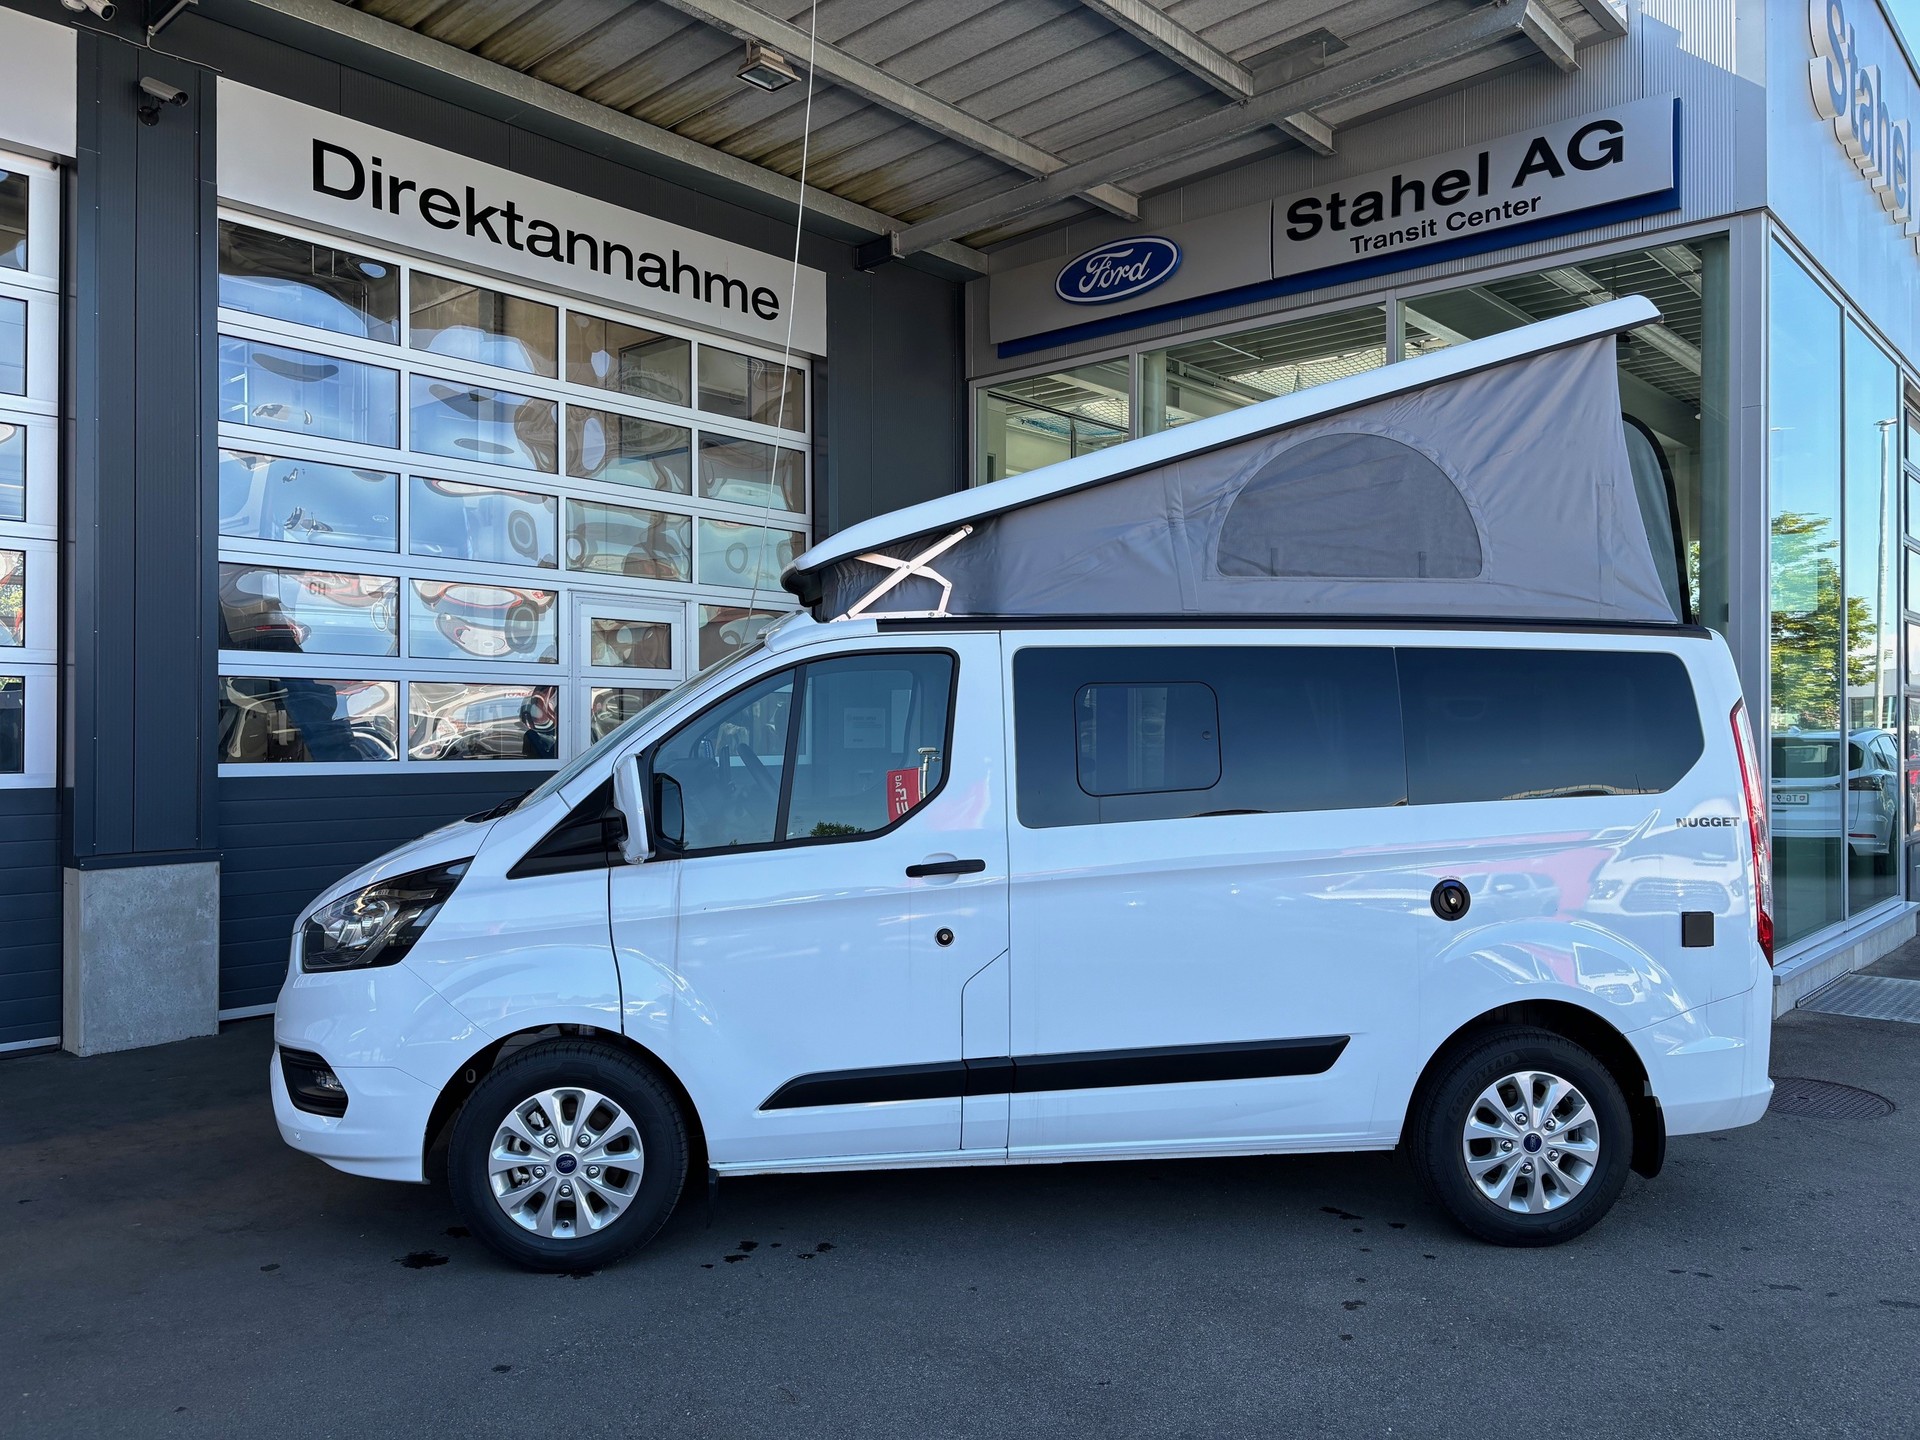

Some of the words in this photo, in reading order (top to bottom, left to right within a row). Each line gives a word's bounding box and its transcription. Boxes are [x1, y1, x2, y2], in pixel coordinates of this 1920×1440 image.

[1286, 151, 1490, 242] Stahel
[1511, 119, 1624, 189] AG
[312, 138, 780, 321] Direktannahme
[1350, 218, 1438, 254] Transit
[1446, 196, 1542, 232] Center
[1079, 248, 1153, 293] Ford
[1676, 817, 1740, 828] NUGGET
